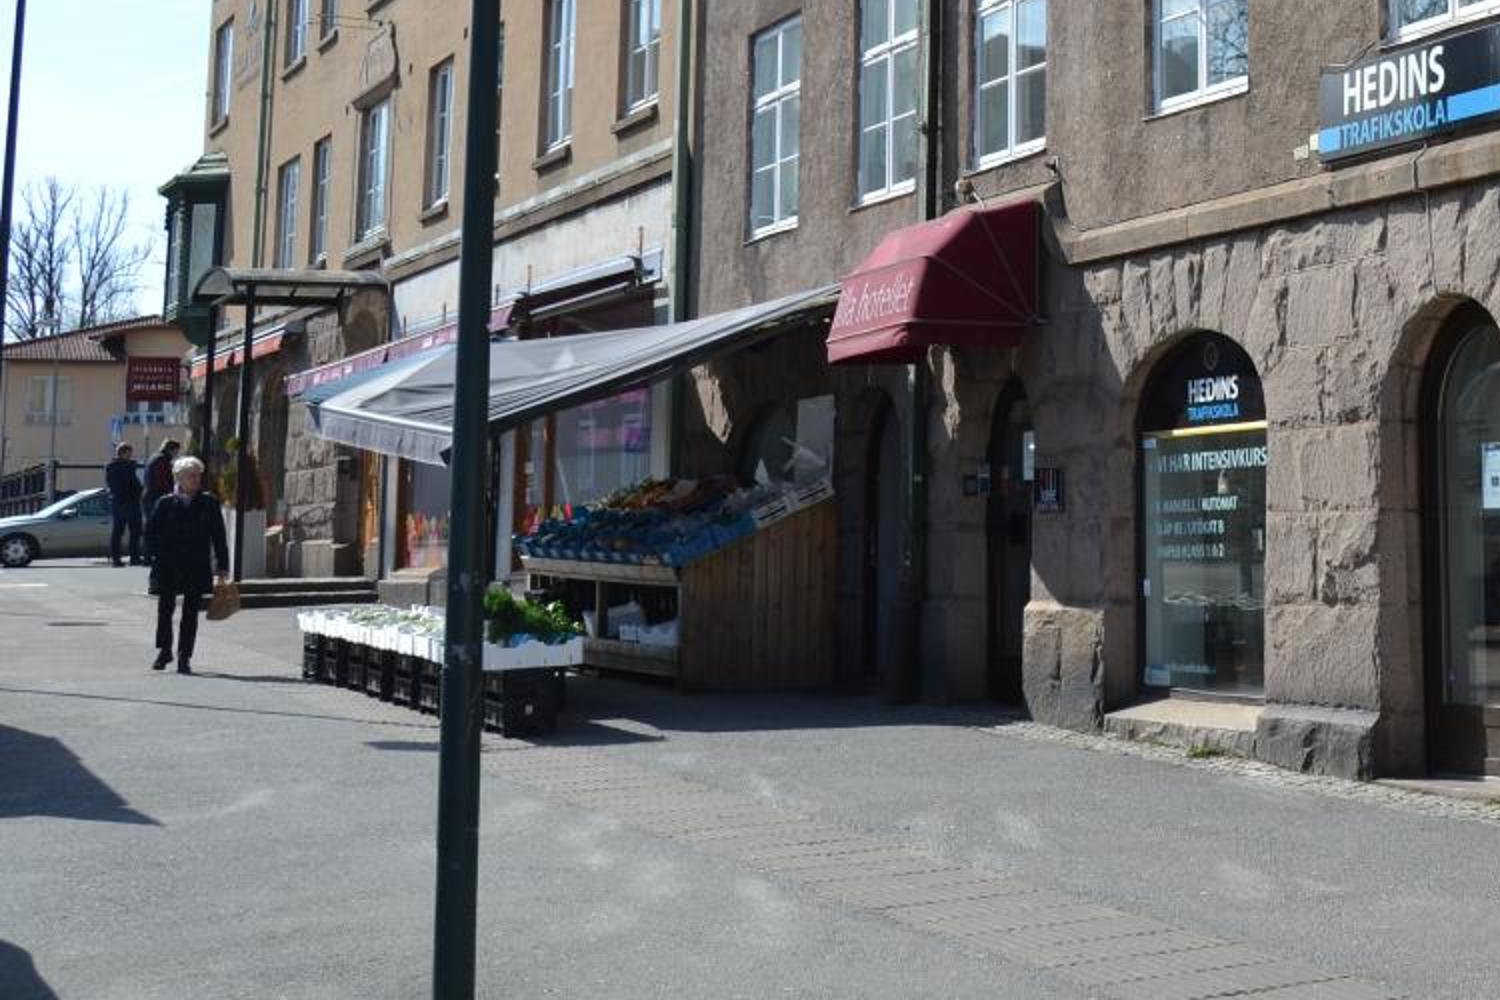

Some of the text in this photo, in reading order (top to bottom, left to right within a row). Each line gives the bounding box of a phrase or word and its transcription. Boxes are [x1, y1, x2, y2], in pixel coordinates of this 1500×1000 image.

[1343, 45, 1446, 115] HEDINS
[1340, 99, 1448, 150] TRAFIKSKOLA
[1187, 376, 1239, 403] HEDINS
